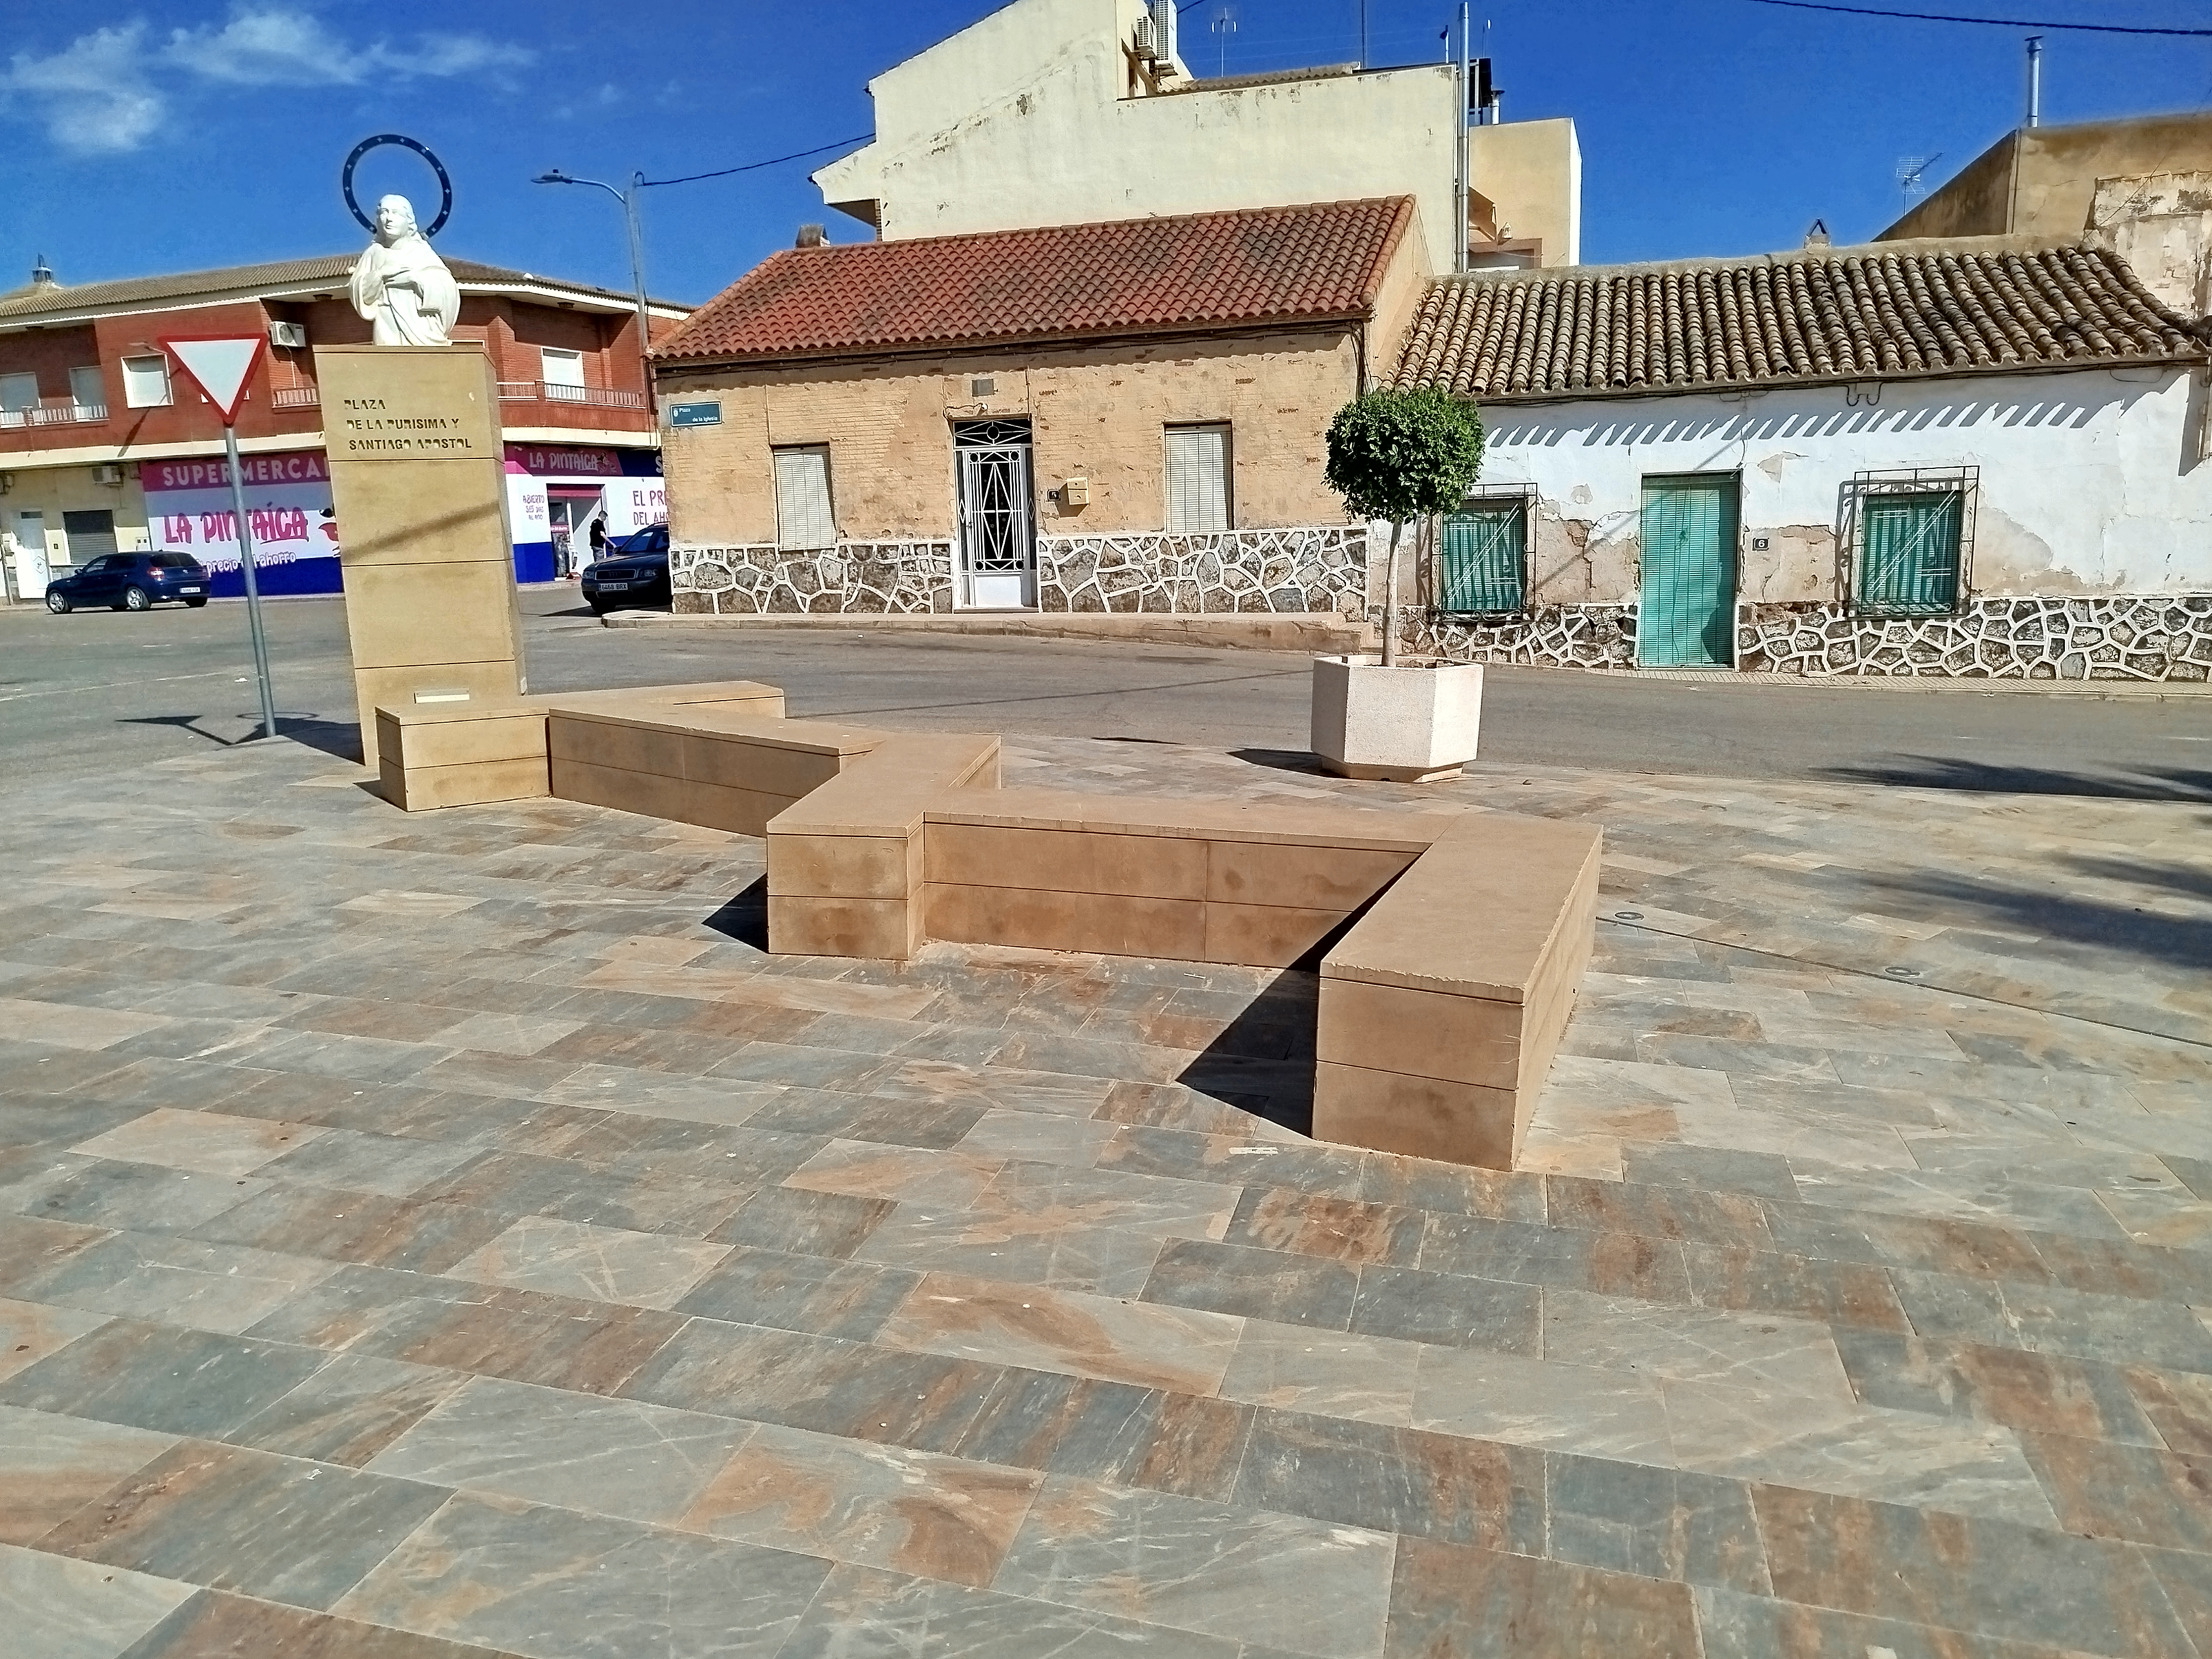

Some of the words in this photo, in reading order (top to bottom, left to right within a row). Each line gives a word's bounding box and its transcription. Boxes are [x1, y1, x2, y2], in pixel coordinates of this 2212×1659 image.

[343, 399, 386, 410] PLAZA
[346, 419, 362, 430] DE
[366, 419, 383, 430] LA
[387, 418, 447, 430] PURISIMA
[451, 418, 459, 429] Y
[349, 439, 411, 451] SANTIAGO
[417, 437, 472, 450] APOSTOL
[529, 452, 545, 469] LA
[163, 457, 330, 487] SUPERMERCA
[523, 494, 545, 504] ABIERTO
[633, 490, 646, 506] EL
[633, 512, 649, 525] DEL
[164, 513, 192, 544] LA
[206, 558, 238, 577] precio
[259, 551, 297, 568] ahorro
